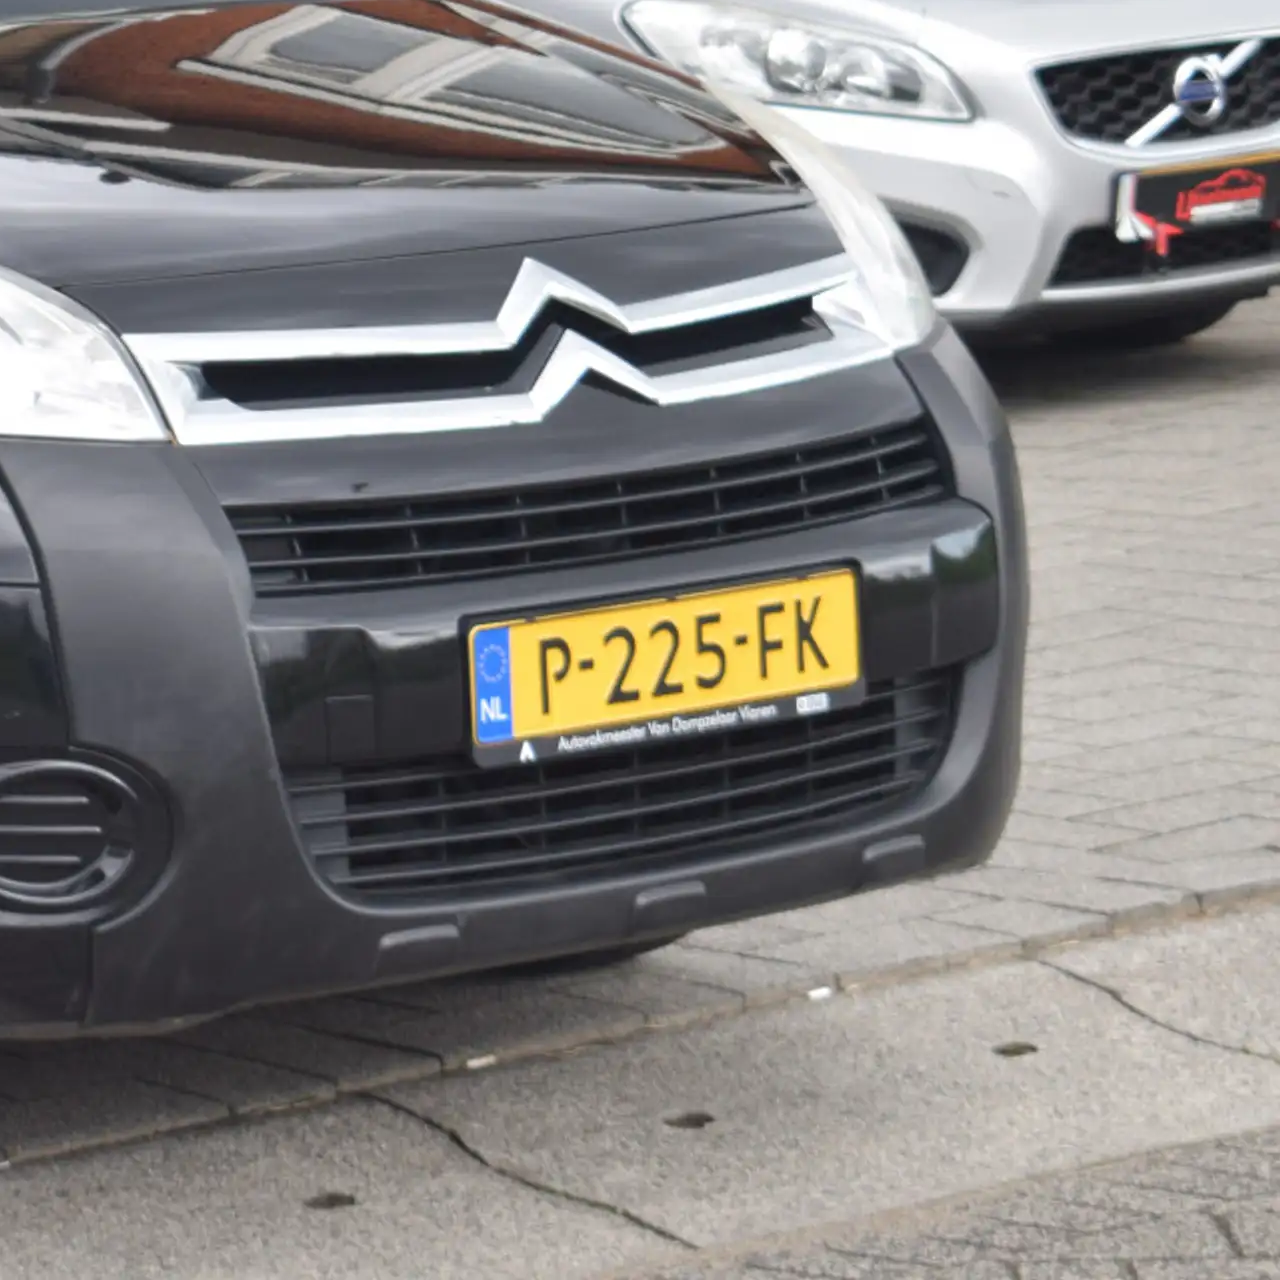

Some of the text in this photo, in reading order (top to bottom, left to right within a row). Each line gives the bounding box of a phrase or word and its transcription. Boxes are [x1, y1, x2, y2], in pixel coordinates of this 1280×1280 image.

[538, 596, 830, 715] P-225-FK
[480, 696, 508, 724] NL
[648, 720, 670, 736] Van
